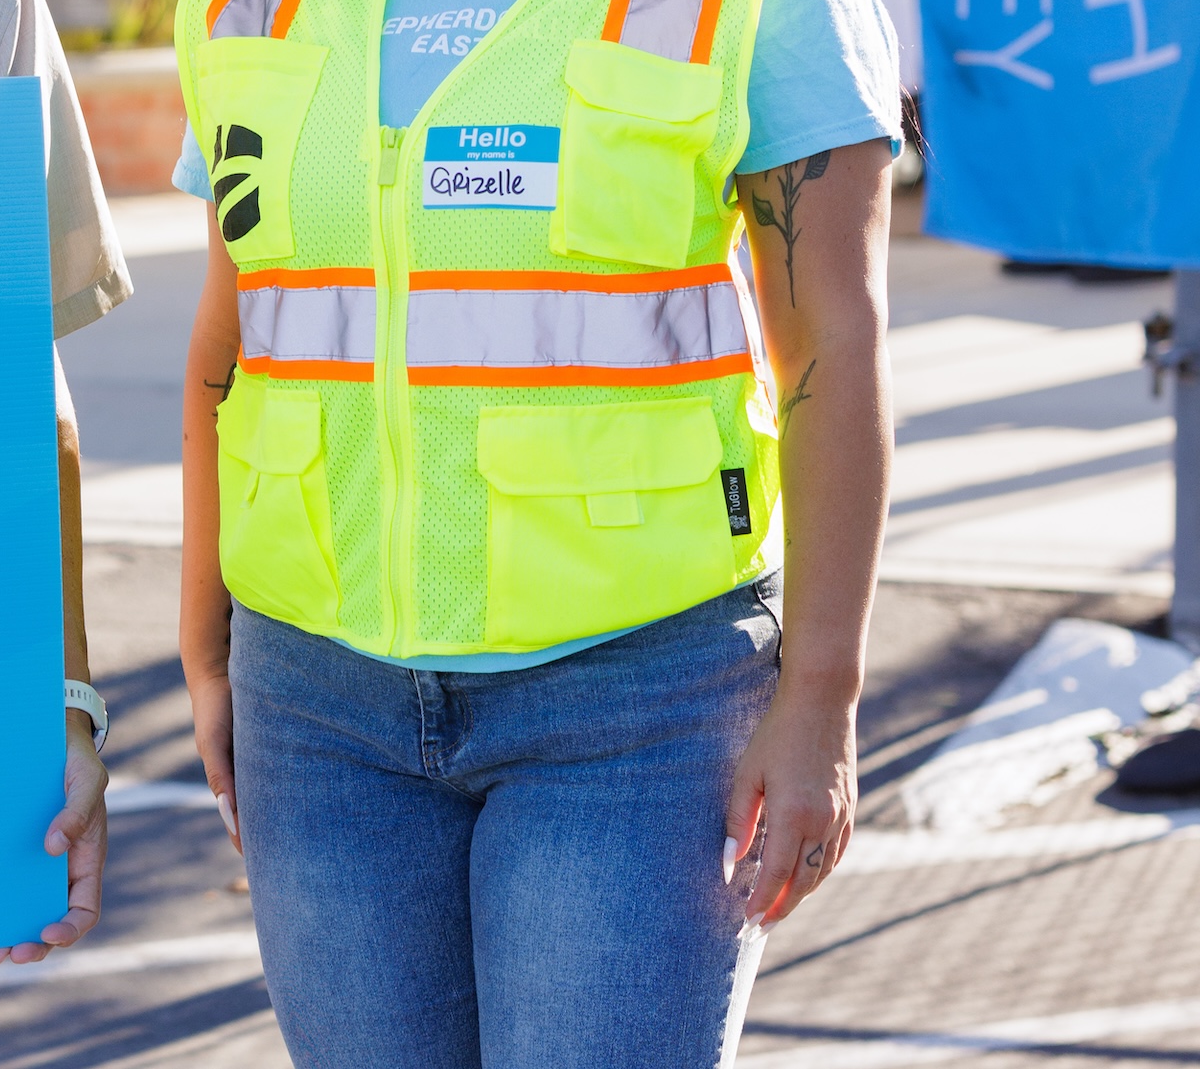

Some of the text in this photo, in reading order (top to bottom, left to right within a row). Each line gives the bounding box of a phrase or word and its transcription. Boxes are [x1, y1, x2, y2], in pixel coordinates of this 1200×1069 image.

[380, 7, 509, 35] EPHERD
[458, 127, 527, 148] Hello
[466, 150, 515, 161] my name is
[728, 476, 742, 514] TuGlow
